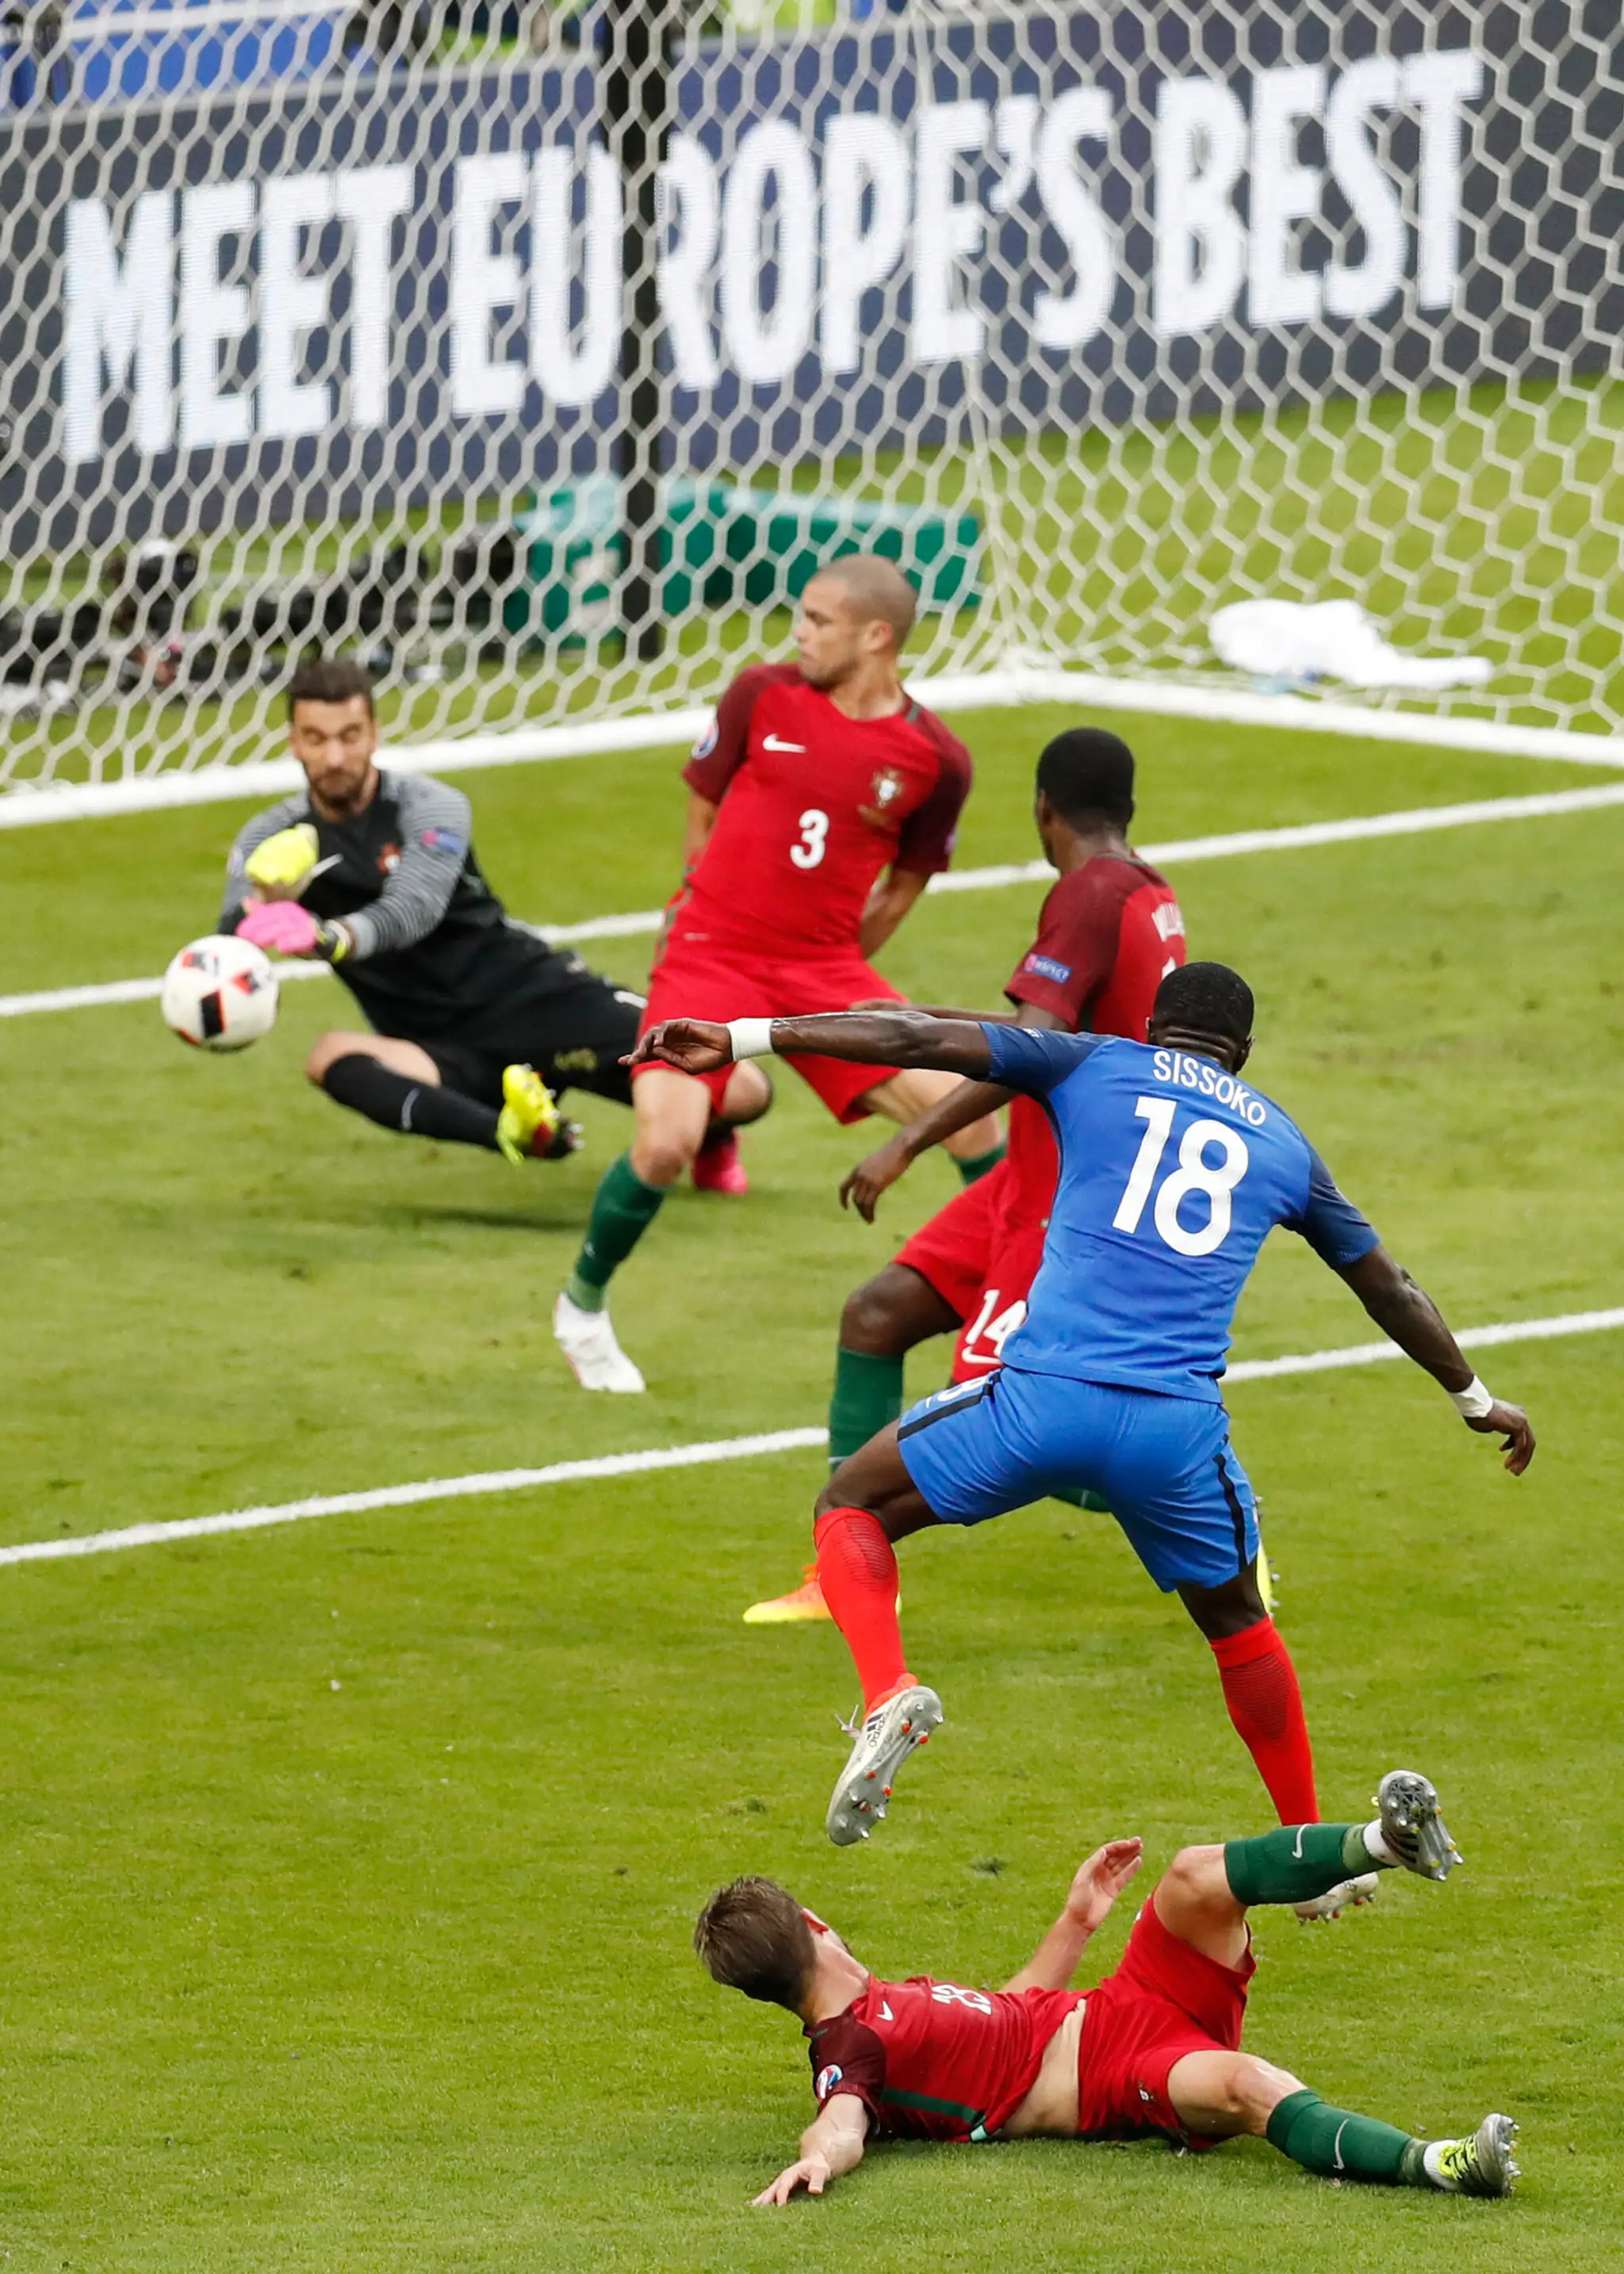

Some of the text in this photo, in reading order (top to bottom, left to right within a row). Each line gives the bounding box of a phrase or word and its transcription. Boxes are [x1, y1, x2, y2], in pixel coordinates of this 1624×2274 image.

[63, 48, 1484, 466] MEET EUROPE'S BEST
[790, 809, 829, 869] 3
[1153, 1051, 1266, 1126] SISSOKO
[1112, 1096, 1249, 1257] 18
[965, 1289, 1028, 1357] 14
